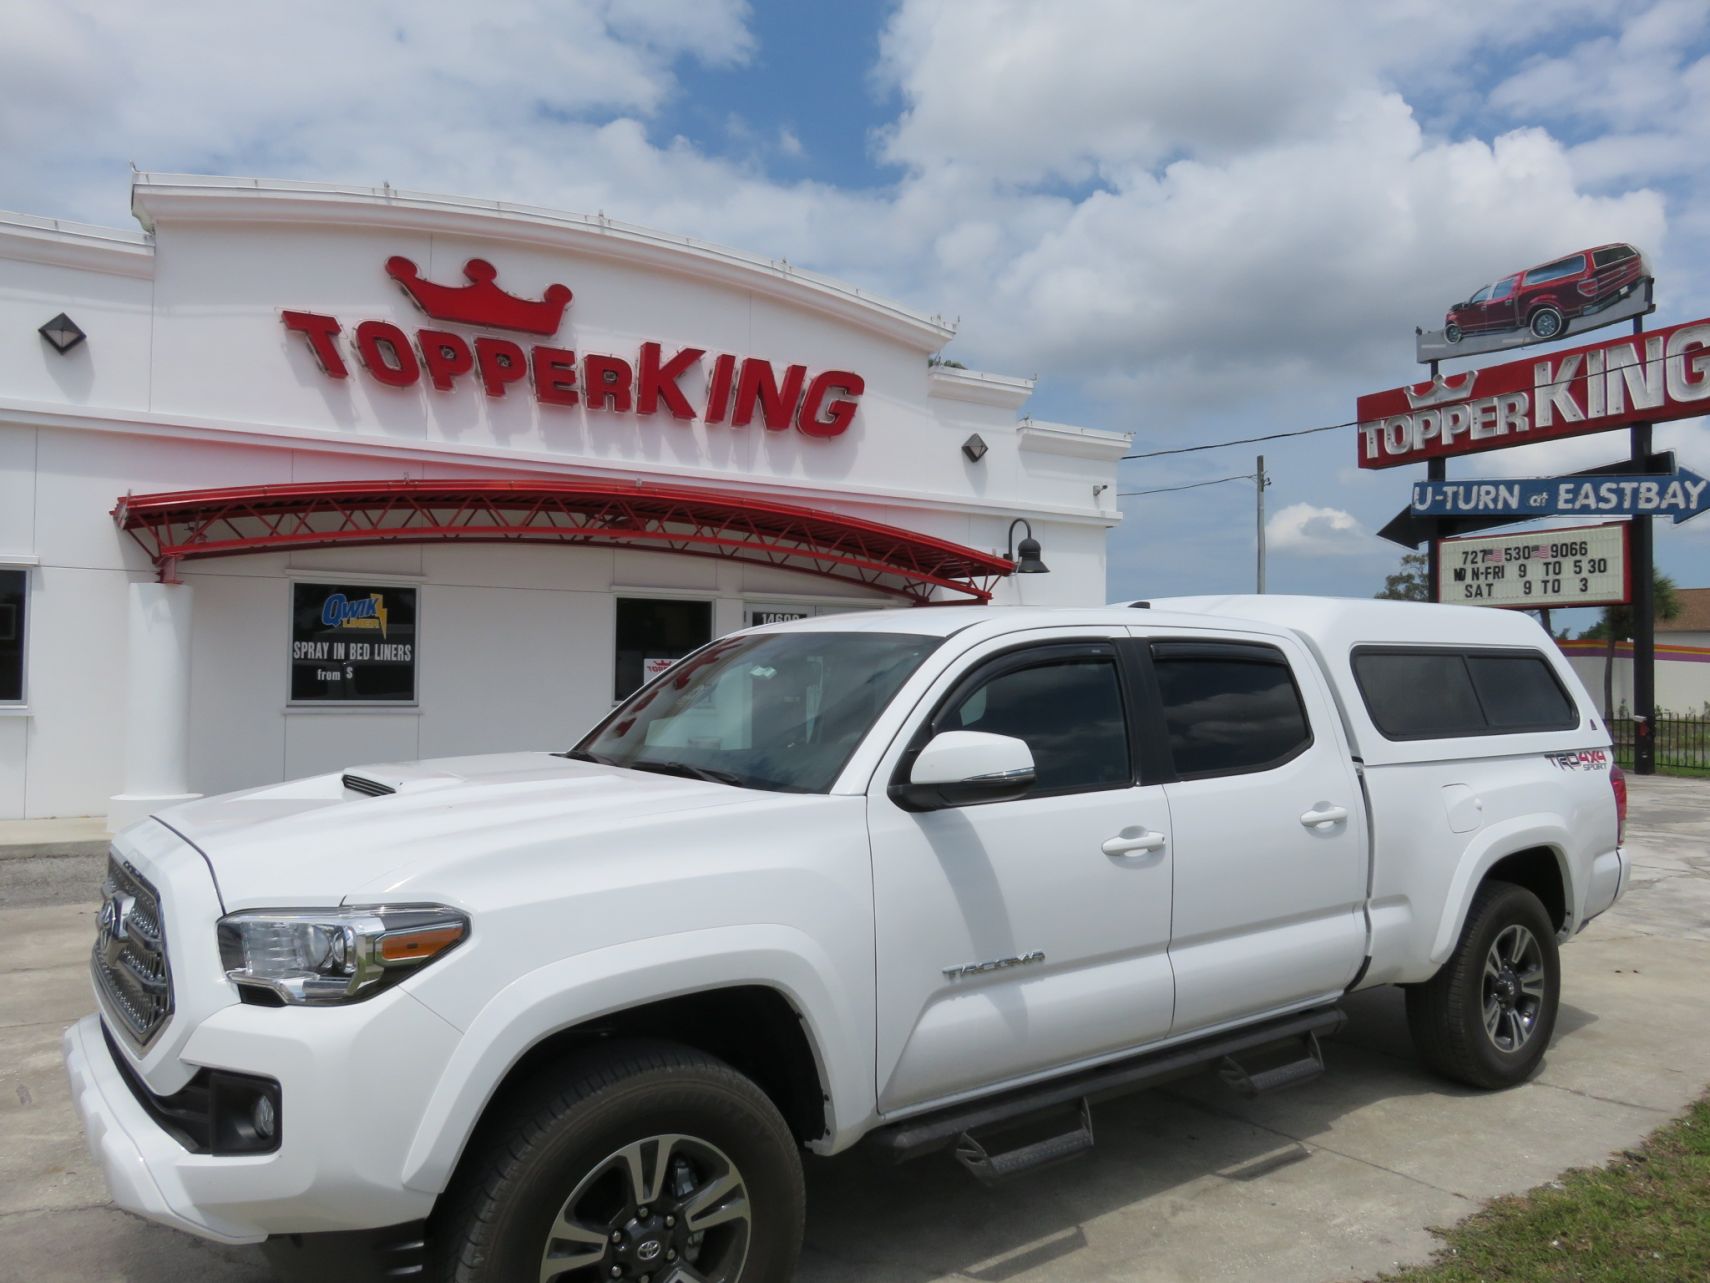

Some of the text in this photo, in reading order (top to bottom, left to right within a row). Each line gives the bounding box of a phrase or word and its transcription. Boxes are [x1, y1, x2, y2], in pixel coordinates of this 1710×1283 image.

[1413, 480, 1707, 511] U-TURN at EASTBAY
[1462, 541, 1588, 565] 727 530 9066
[1518, 563, 1527, 578] 9
[1543, 561, 1562, 576] TO
[1464, 577, 1588, 598] SAT 9 TO 3
[293, 641, 412, 661] SPRAY IN BED LINERS
[317, 668, 341, 681] from
[1544, 752, 1581, 771] TRD
[1583, 762, 1608, 771] SPORT
